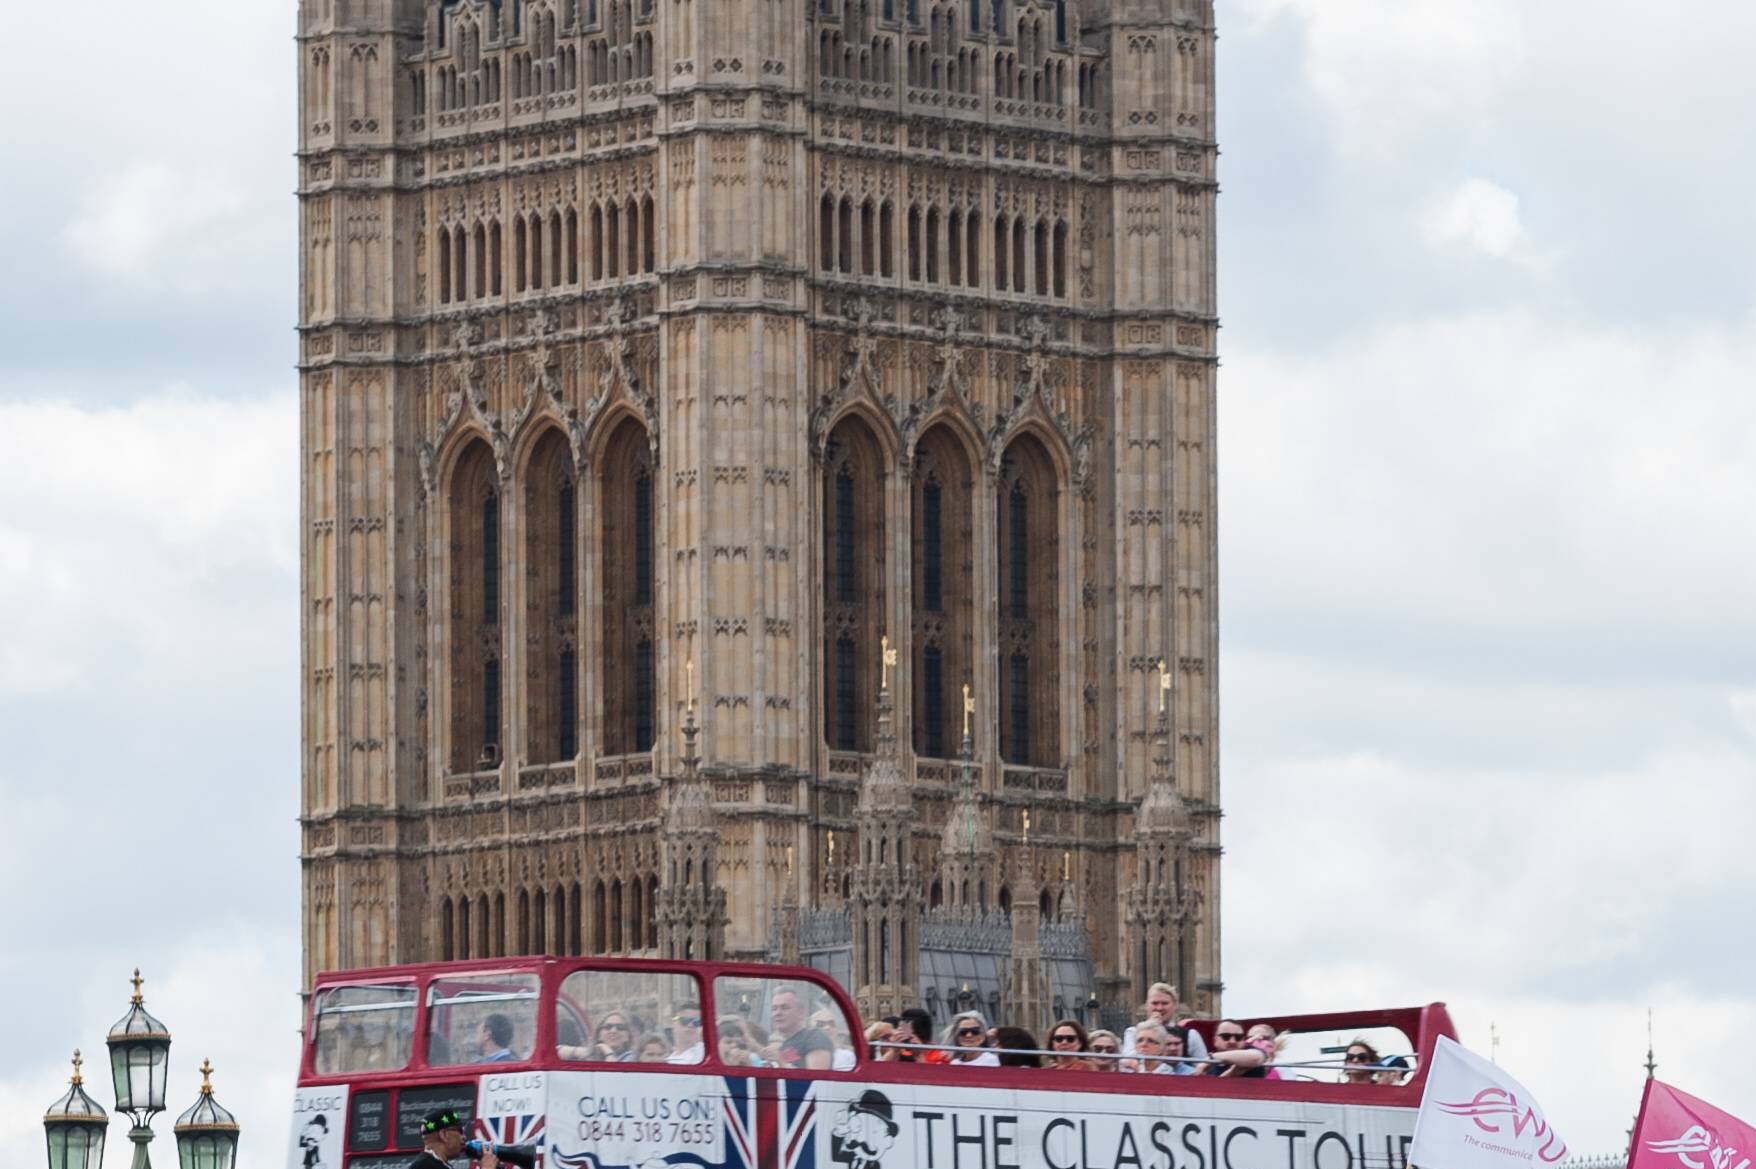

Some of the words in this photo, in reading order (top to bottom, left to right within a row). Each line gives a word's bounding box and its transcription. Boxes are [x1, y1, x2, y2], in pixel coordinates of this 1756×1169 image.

[486, 1076, 518, 1092] CALL
[523, 1075, 543, 1089] US
[577, 1096, 634, 1119] CALL
[642, 1098, 671, 1119] US
[577, 1120, 626, 1141] 0844
[633, 1122, 663, 1142] 318
[669, 1123, 715, 1144] 7655
[1464, 1134, 1480, 1146] The
